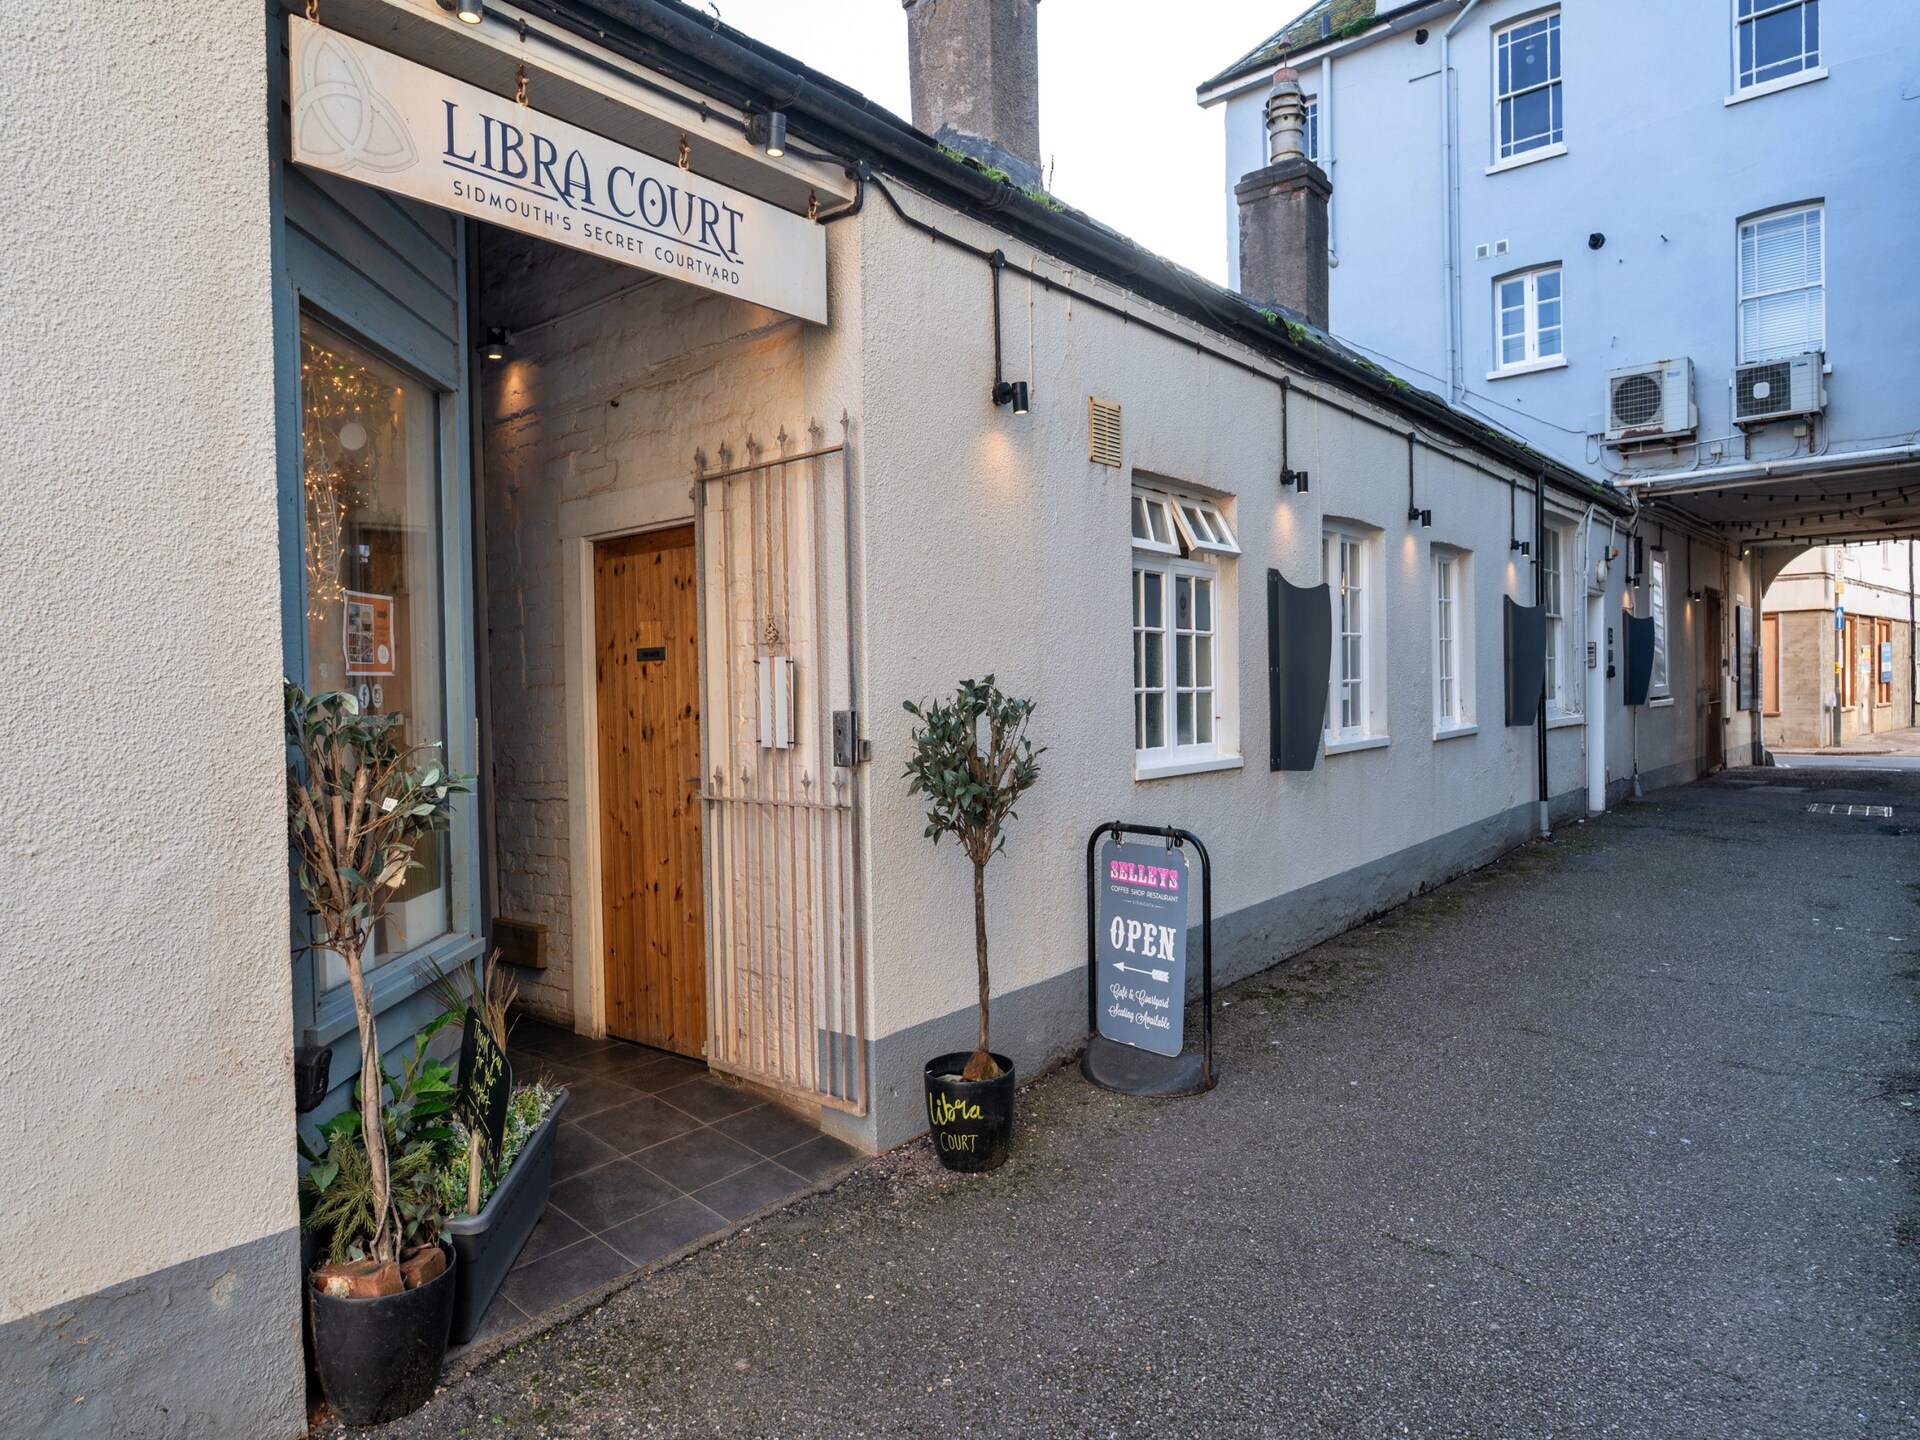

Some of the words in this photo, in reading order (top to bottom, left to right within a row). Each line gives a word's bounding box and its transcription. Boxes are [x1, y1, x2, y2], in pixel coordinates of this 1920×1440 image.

[442, 99, 596, 210] LIBRA
[607, 165, 744, 264] COURT
[453, 181, 572, 231] SIDMOUTH'S
[584, 223, 643, 254] SECRET
[655, 247, 740, 285] COURTYARD
[1110, 860, 1179, 891] SELLEYS
[1111, 885, 1129, 894] COFFEE
[1131, 888, 1145, 896] SHOP
[1147, 891, 1178, 903] RESTAURANT
[1110, 916, 1176, 961] OPEN
[1128, 988, 1135, 1001] &
[1135, 989, 1169, 1009] Courtyard
[1108, 1003, 1134, 1023] Seating
[1136, 1011, 1170, 1029] Available
[940, 1131, 979, 1153] COURT
